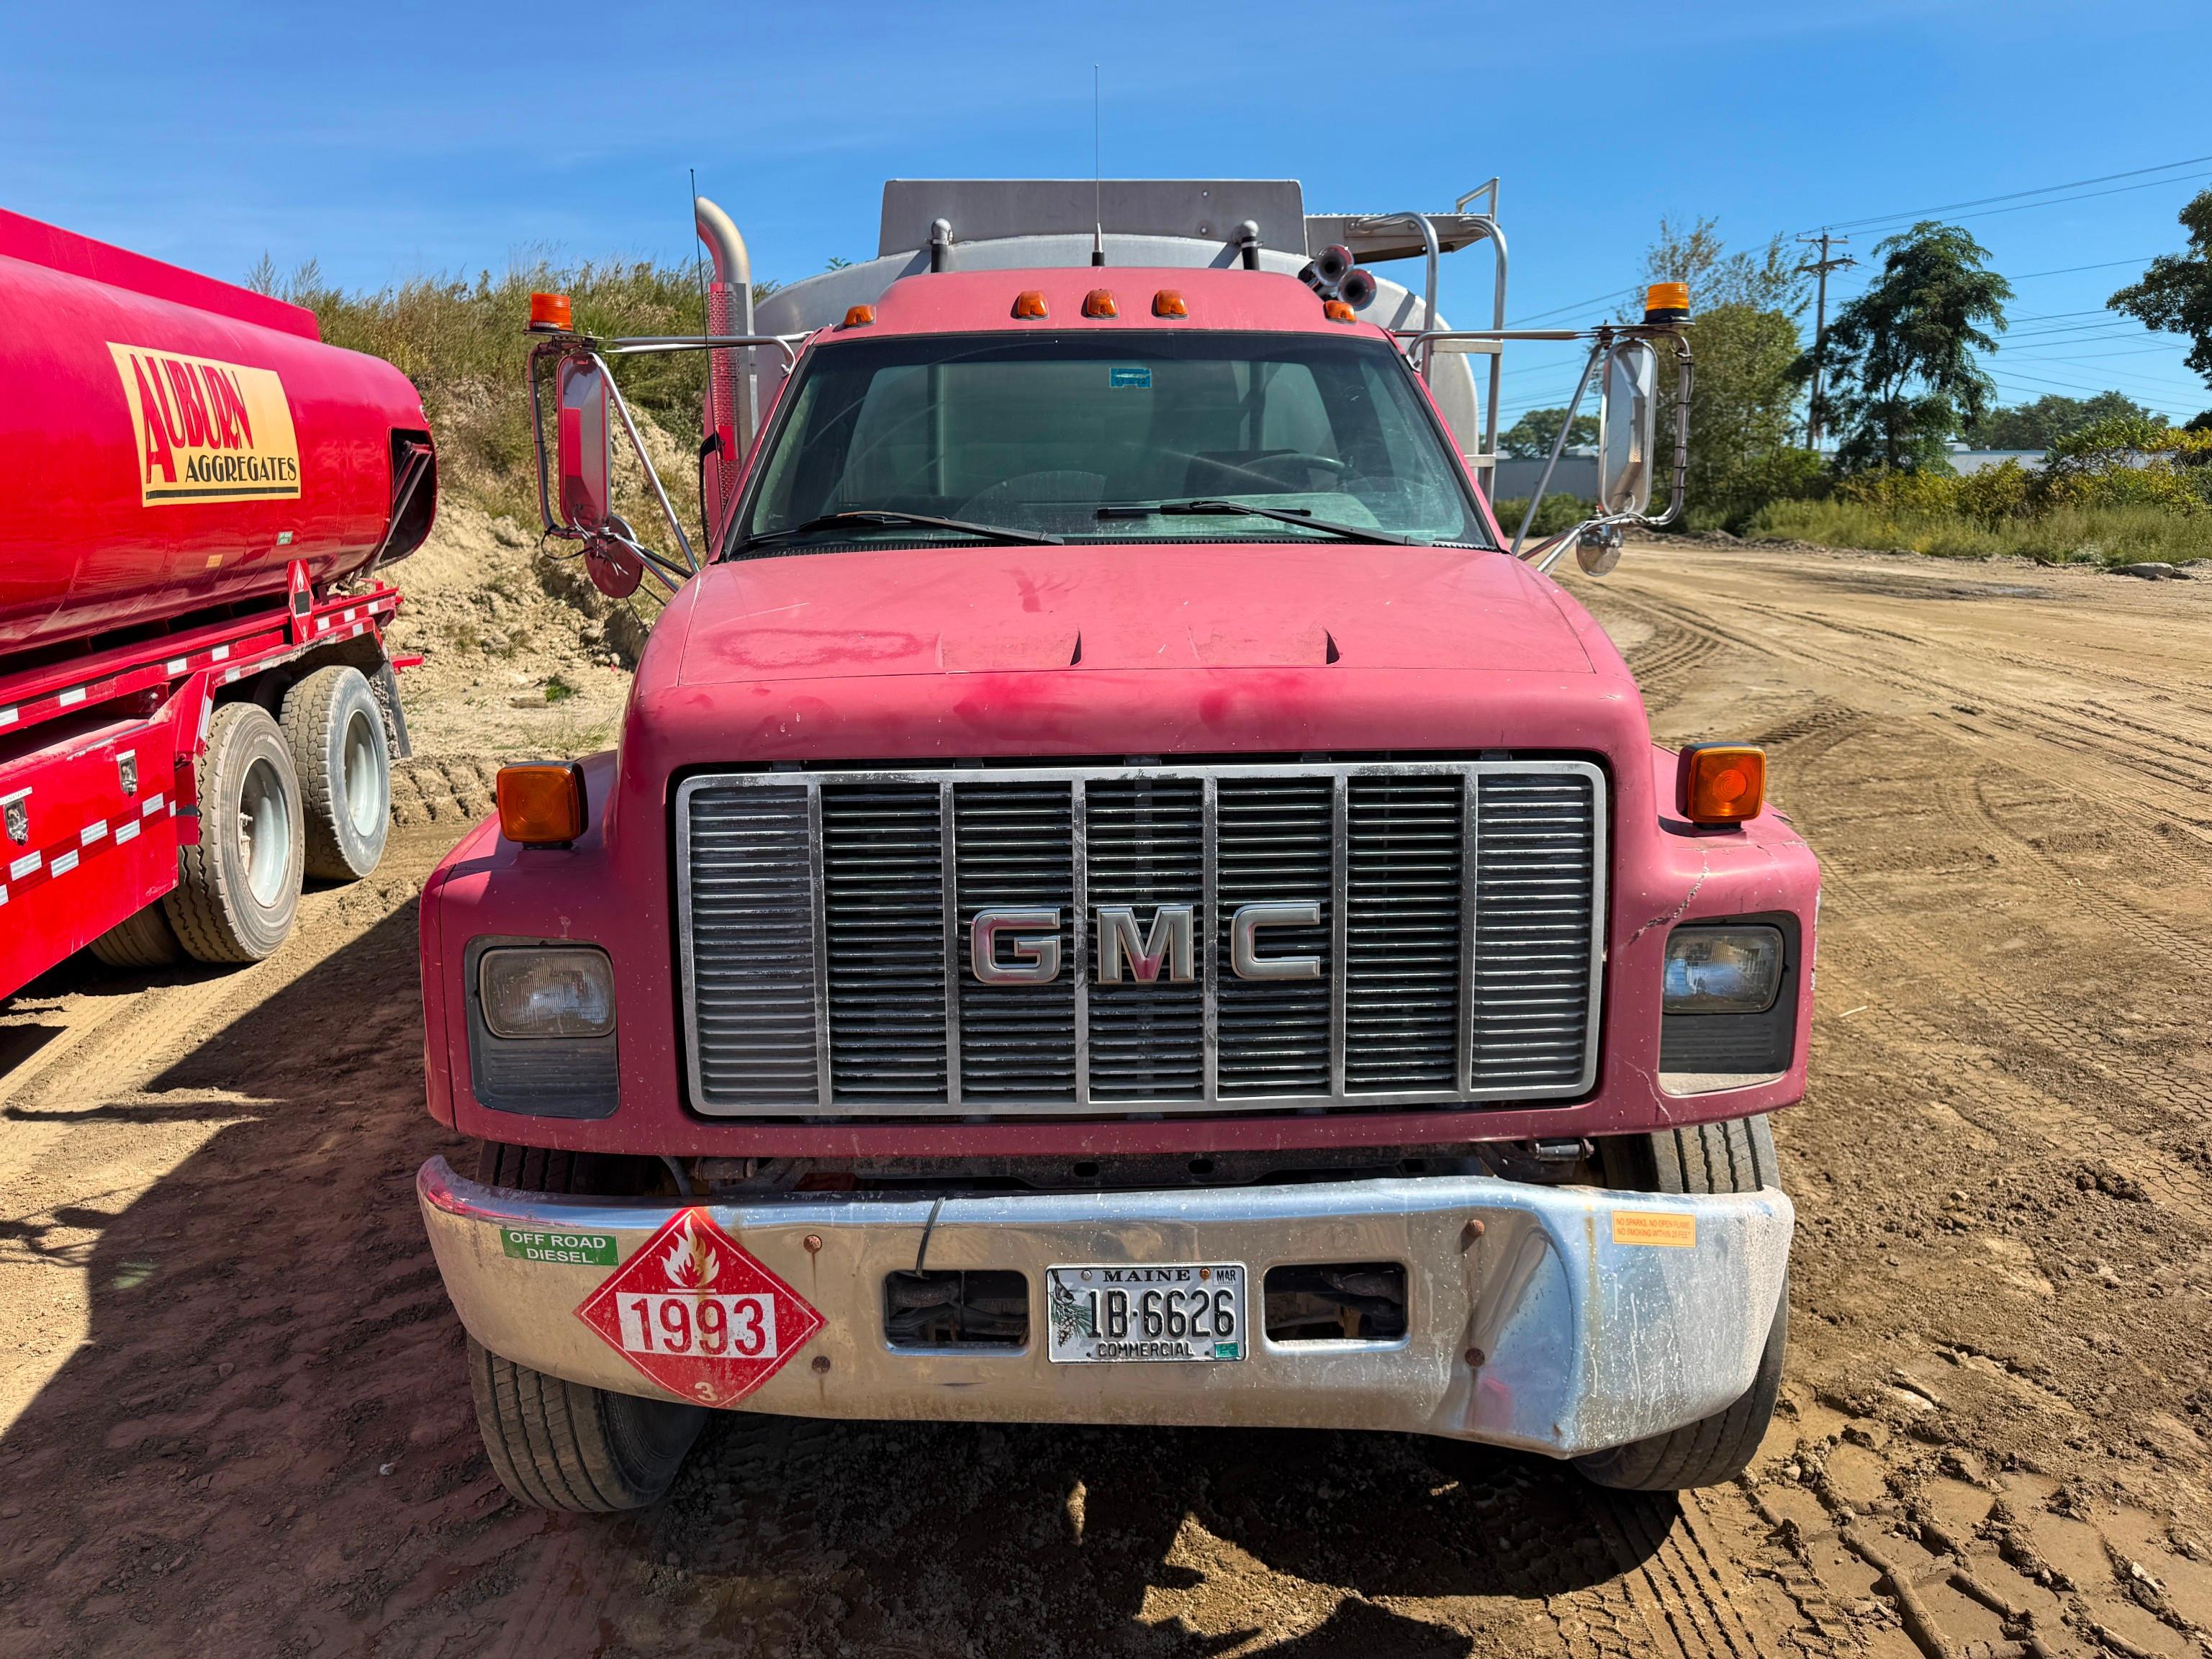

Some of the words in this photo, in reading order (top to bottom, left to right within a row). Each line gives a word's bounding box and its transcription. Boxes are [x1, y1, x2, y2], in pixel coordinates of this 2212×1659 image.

[130, 353, 254, 484] AUBURN
[185, 454, 297, 483] AGGREGATES
[971, 903, 1321, 984] GMC
[510, 1231, 545, 1245] OFF
[551, 1234, 606, 1249] ROAD
[1627, 1228, 1652, 1237] SMOKING
[1653, 1229, 1671, 1238] WITHIN
[526, 1247, 594, 1264] DIESEL
[1103, 1270, 1191, 1282] MAINE
[1216, 1270, 1236, 1281] MAR
[631, 1298, 767, 1356] 1993
[1098, 1342, 1195, 1357] COMMERCIAL
[695, 1382, 718, 1401] 3
